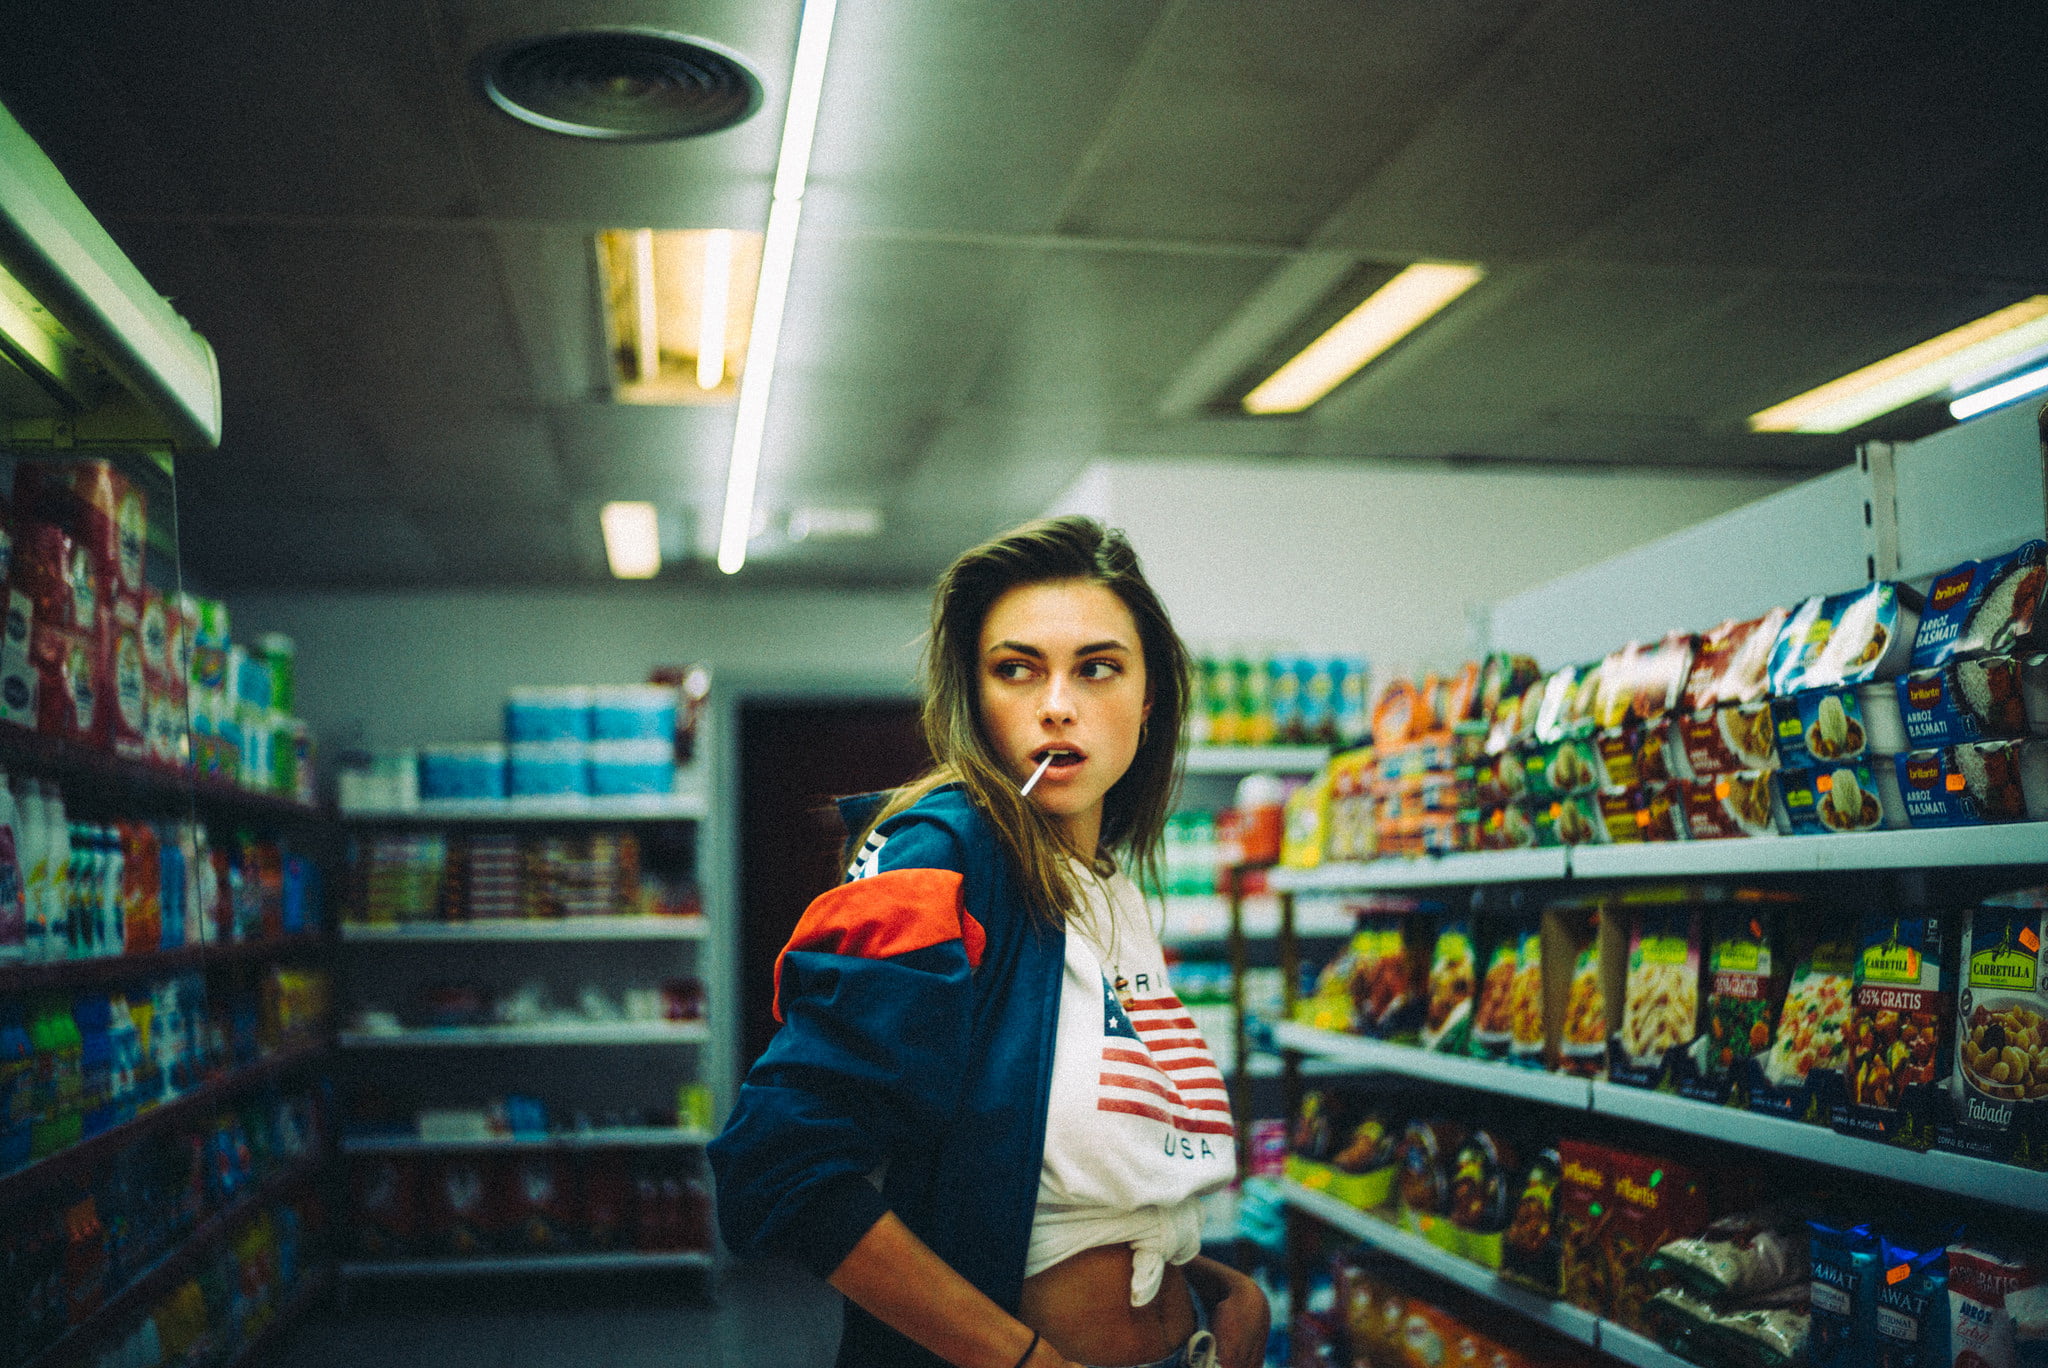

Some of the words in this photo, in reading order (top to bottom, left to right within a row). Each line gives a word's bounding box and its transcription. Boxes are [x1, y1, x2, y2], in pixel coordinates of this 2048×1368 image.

[1919, 614, 1950, 633] ARROZ
[1915, 624, 1959, 648] BASMATI
[1909, 686, 1941, 701] brillante
[1907, 710, 1932, 723] ARROZ
[1908, 719, 1948, 737] BASMATI
[1908, 766, 1939, 780] brillante
[1906, 790, 1931, 802] ARROZ
[1908, 799, 1947, 816] BASMATI
[1864, 957, 1907, 972] CARRETILL
[1972, 962, 2031, 979] CARRETILLA
[1880, 990, 1922, 1010] GRATIS
[1967, 1097, 2013, 1125] Fabada
[1164, 1132, 1215, 1160] USA
